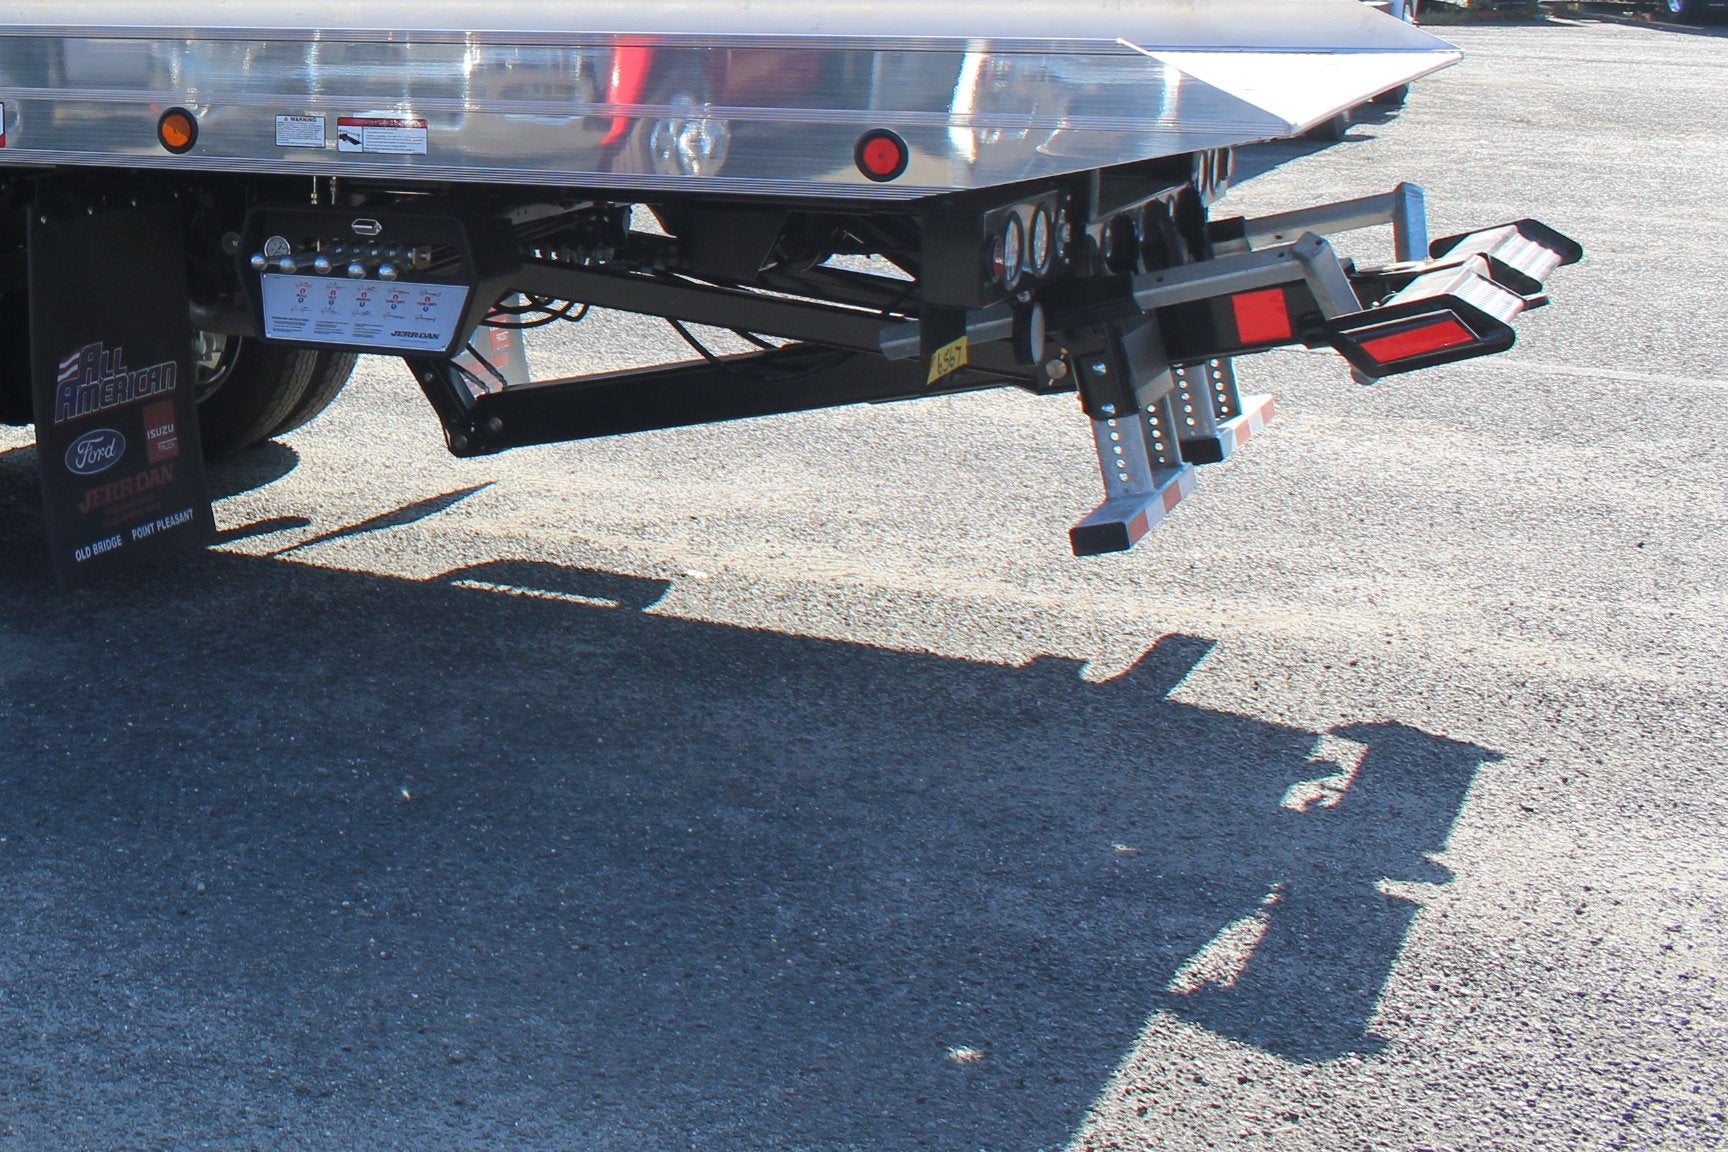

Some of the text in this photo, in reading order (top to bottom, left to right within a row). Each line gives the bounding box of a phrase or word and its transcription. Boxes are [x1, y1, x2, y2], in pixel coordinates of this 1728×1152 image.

[79, 342, 128, 385] ALL
[55, 361, 177, 424] AMERICAN
[75, 436, 117, 469] Ford
[147, 423, 174, 439] ISUZU
[75, 547, 91, 562] OLD
[92, 535, 122, 556] BRIDGE
[131, 523, 155, 540] POINT
[156, 508, 194, 532] PLEASANT
